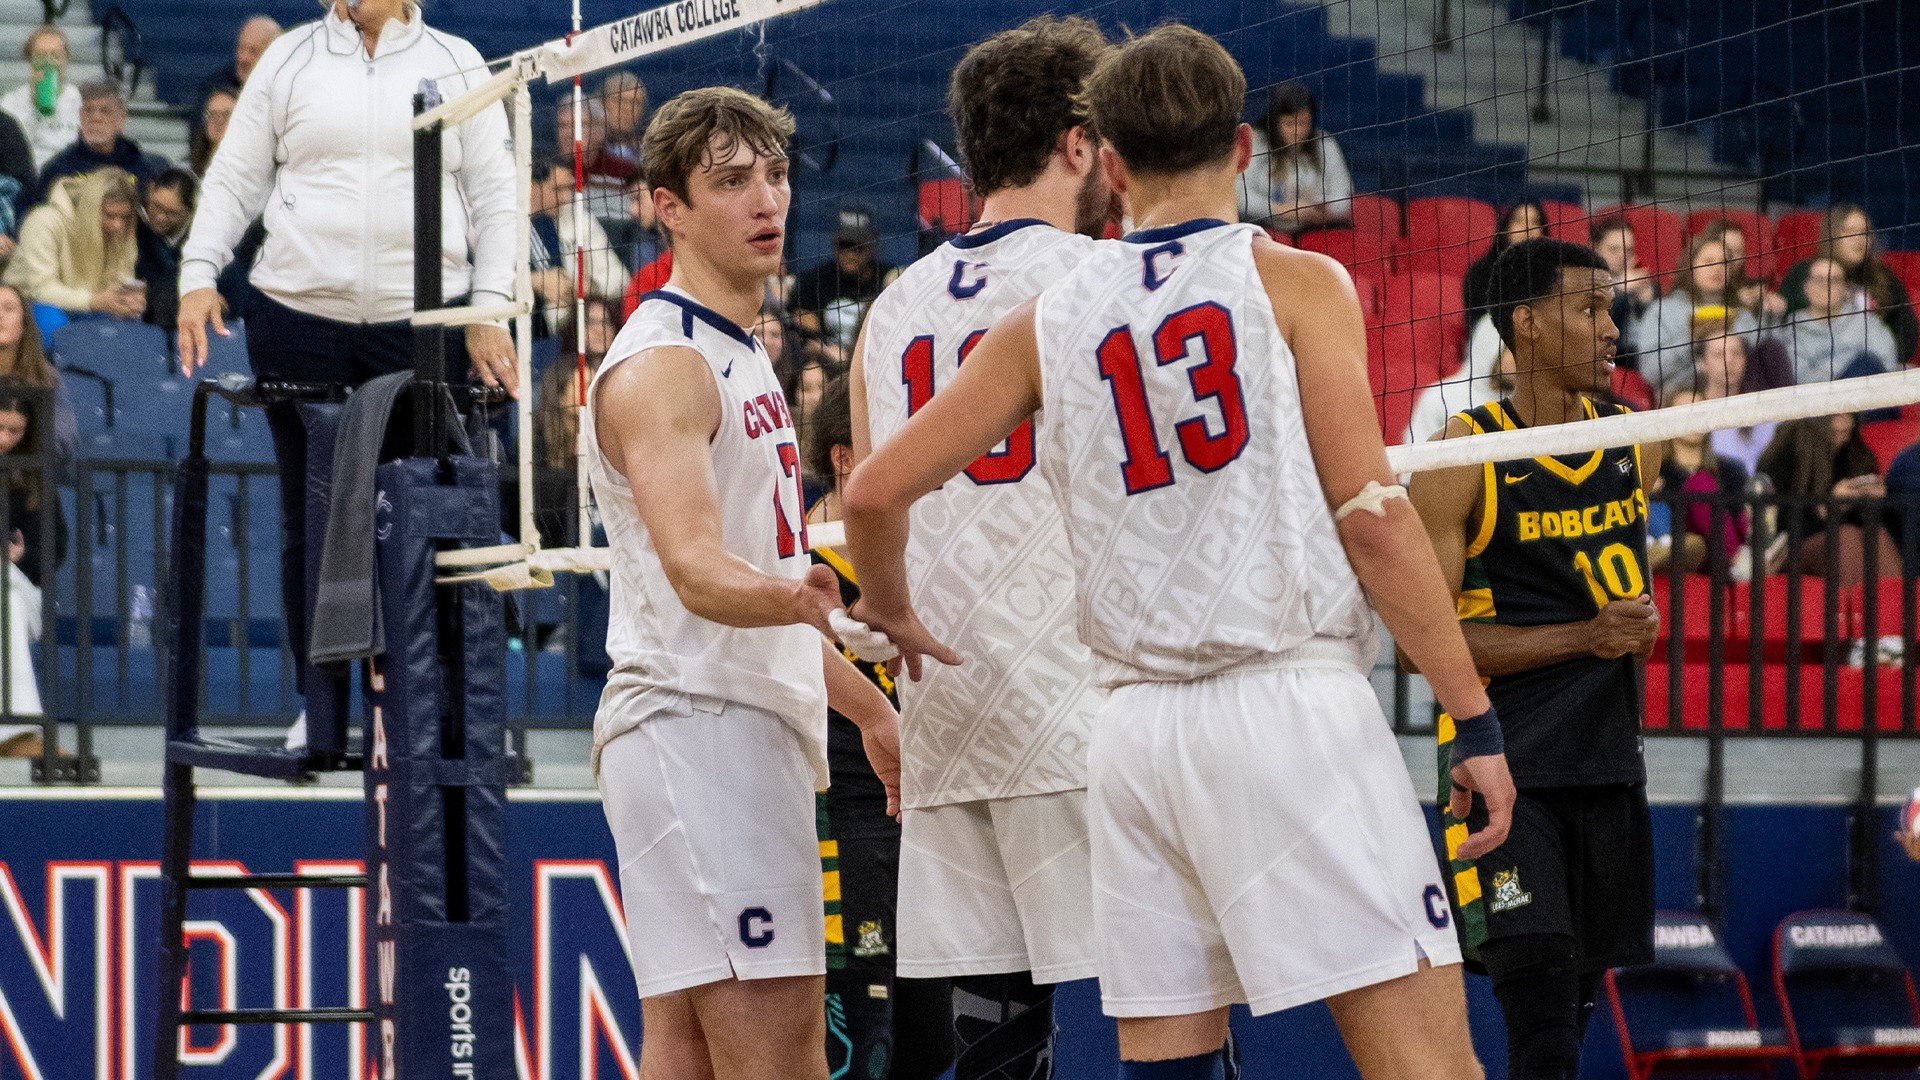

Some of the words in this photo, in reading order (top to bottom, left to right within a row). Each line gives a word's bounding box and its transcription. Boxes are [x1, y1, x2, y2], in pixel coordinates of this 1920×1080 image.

[610, 12, 674, 53] CATAWBA
[676, 0, 740, 34] COLLEGE
[946, 258, 989, 302] C
[1142, 239, 1186, 292] C
[1095, 299, 1251, 496] 13
[1573, 542, 1645, 609] 10
[737, 906, 776, 949] C
[1421, 882, 1450, 931] C
[1789, 923, 1884, 948] CATAWBA
[444, 966, 476, 1058] sports
